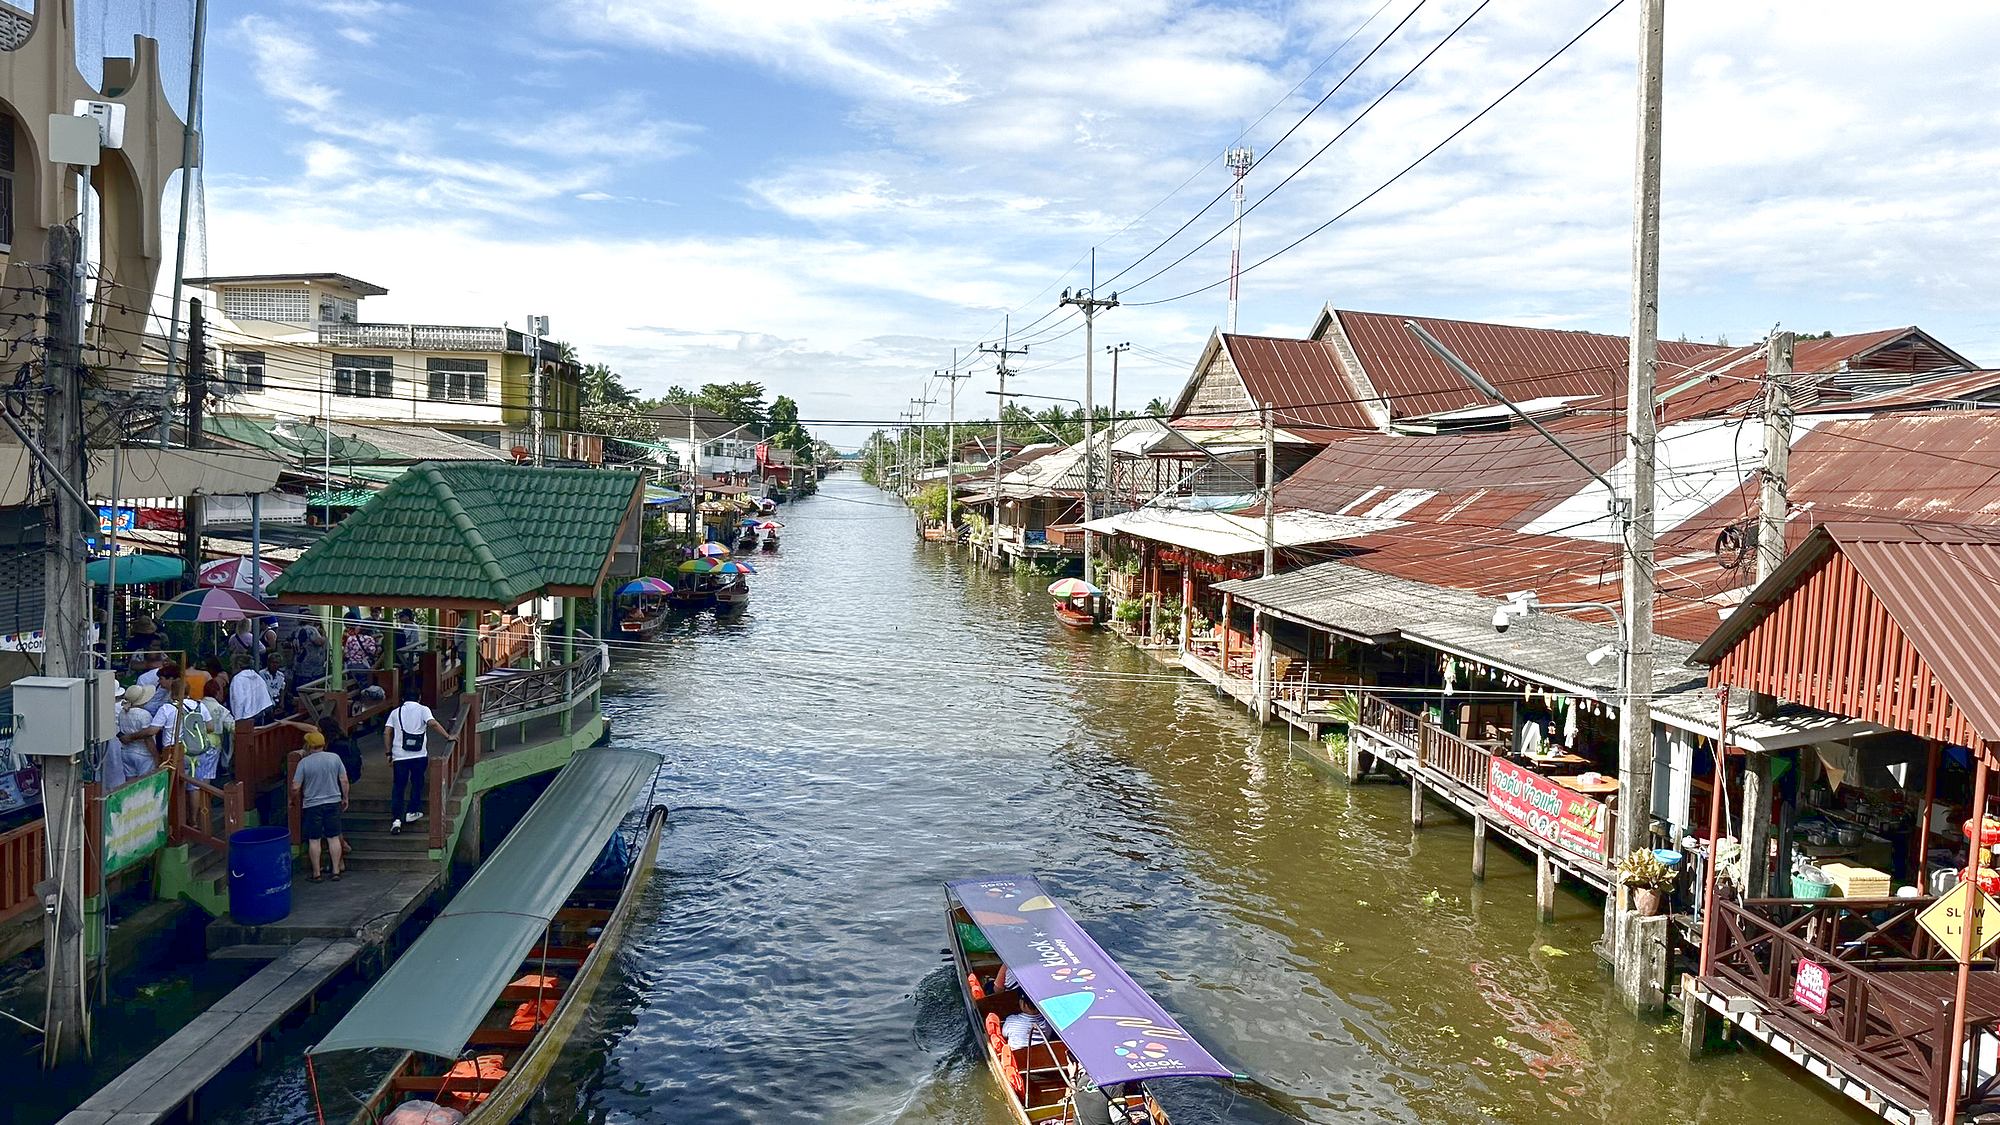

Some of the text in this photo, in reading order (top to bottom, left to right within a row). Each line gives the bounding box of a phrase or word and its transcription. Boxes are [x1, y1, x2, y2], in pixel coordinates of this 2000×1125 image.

[1946, 907, 1986, 918] SLW
[1947, 925, 1984, 936] LIE
[1027, 939, 1069, 967] klook
[1126, 1058, 1184, 1070] klook
